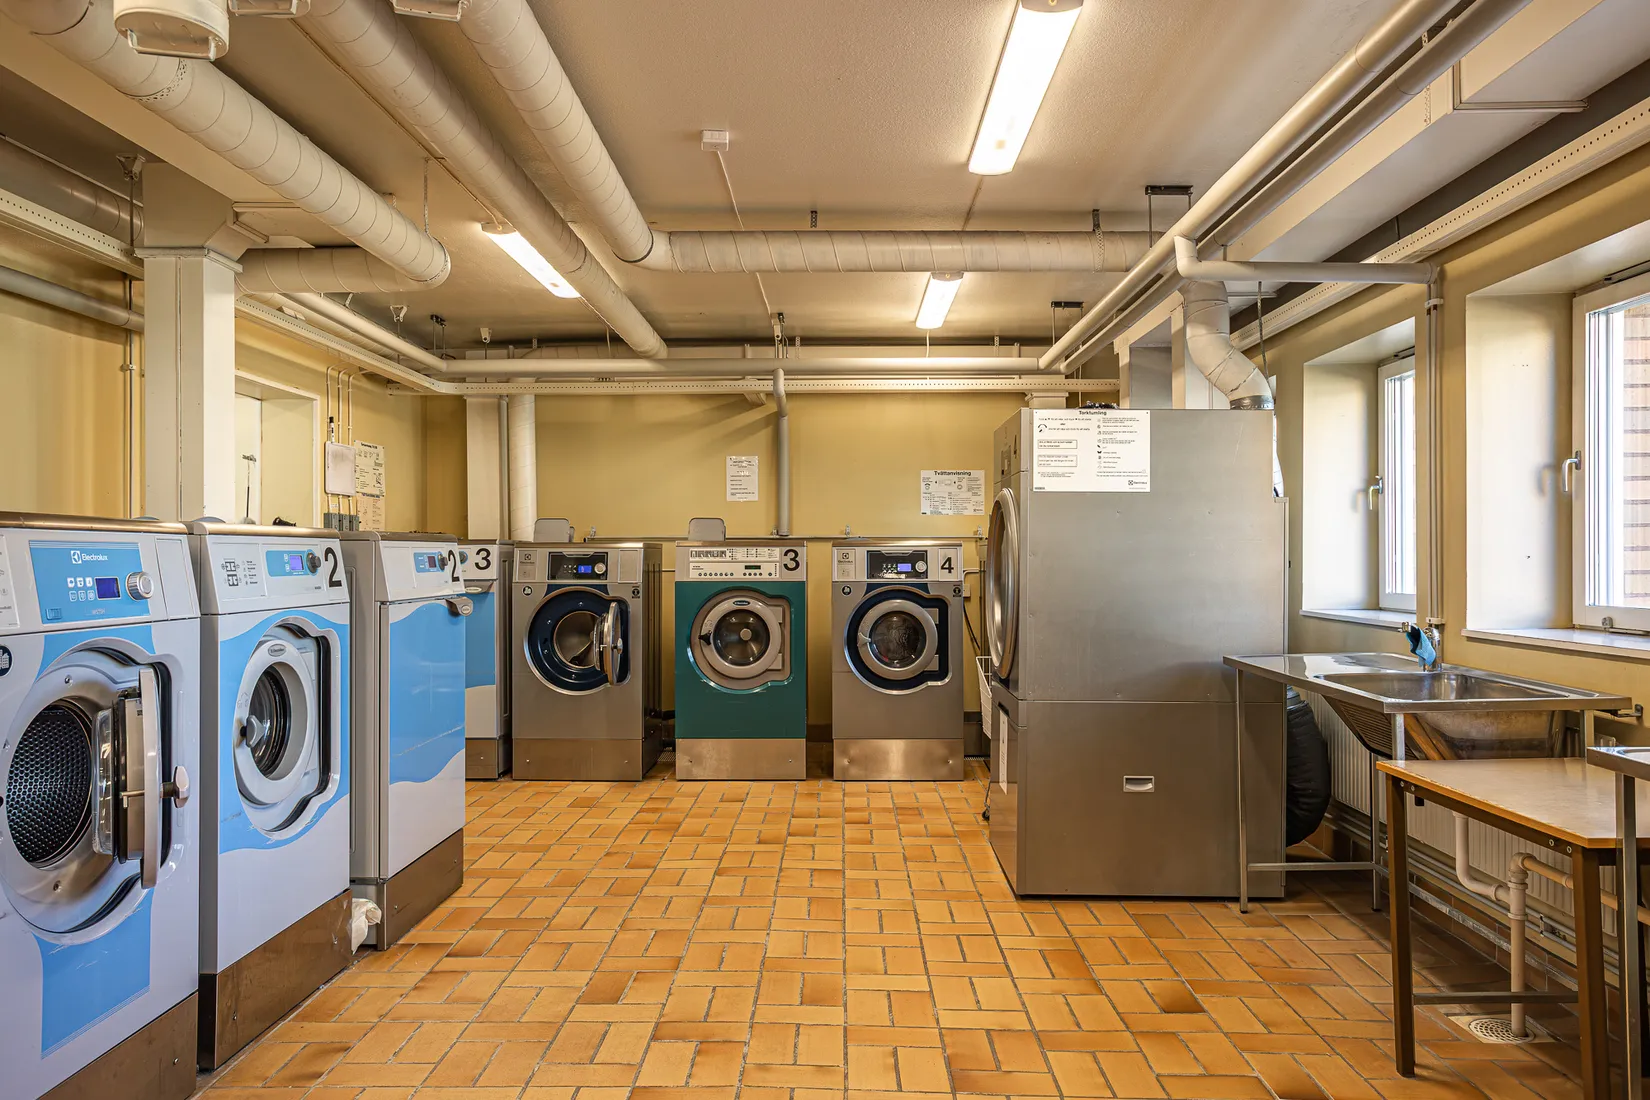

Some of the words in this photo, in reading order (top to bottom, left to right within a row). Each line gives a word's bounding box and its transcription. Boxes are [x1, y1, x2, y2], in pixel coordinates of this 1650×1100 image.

[81, 553, 108, 561] Electrolux
[324, 546, 343, 588] 2
[447, 549, 460, 583] 2
[474, 547, 492, 571] 3
[783, 548, 800, 572] 3
[940, 556, 954, 574] 4
